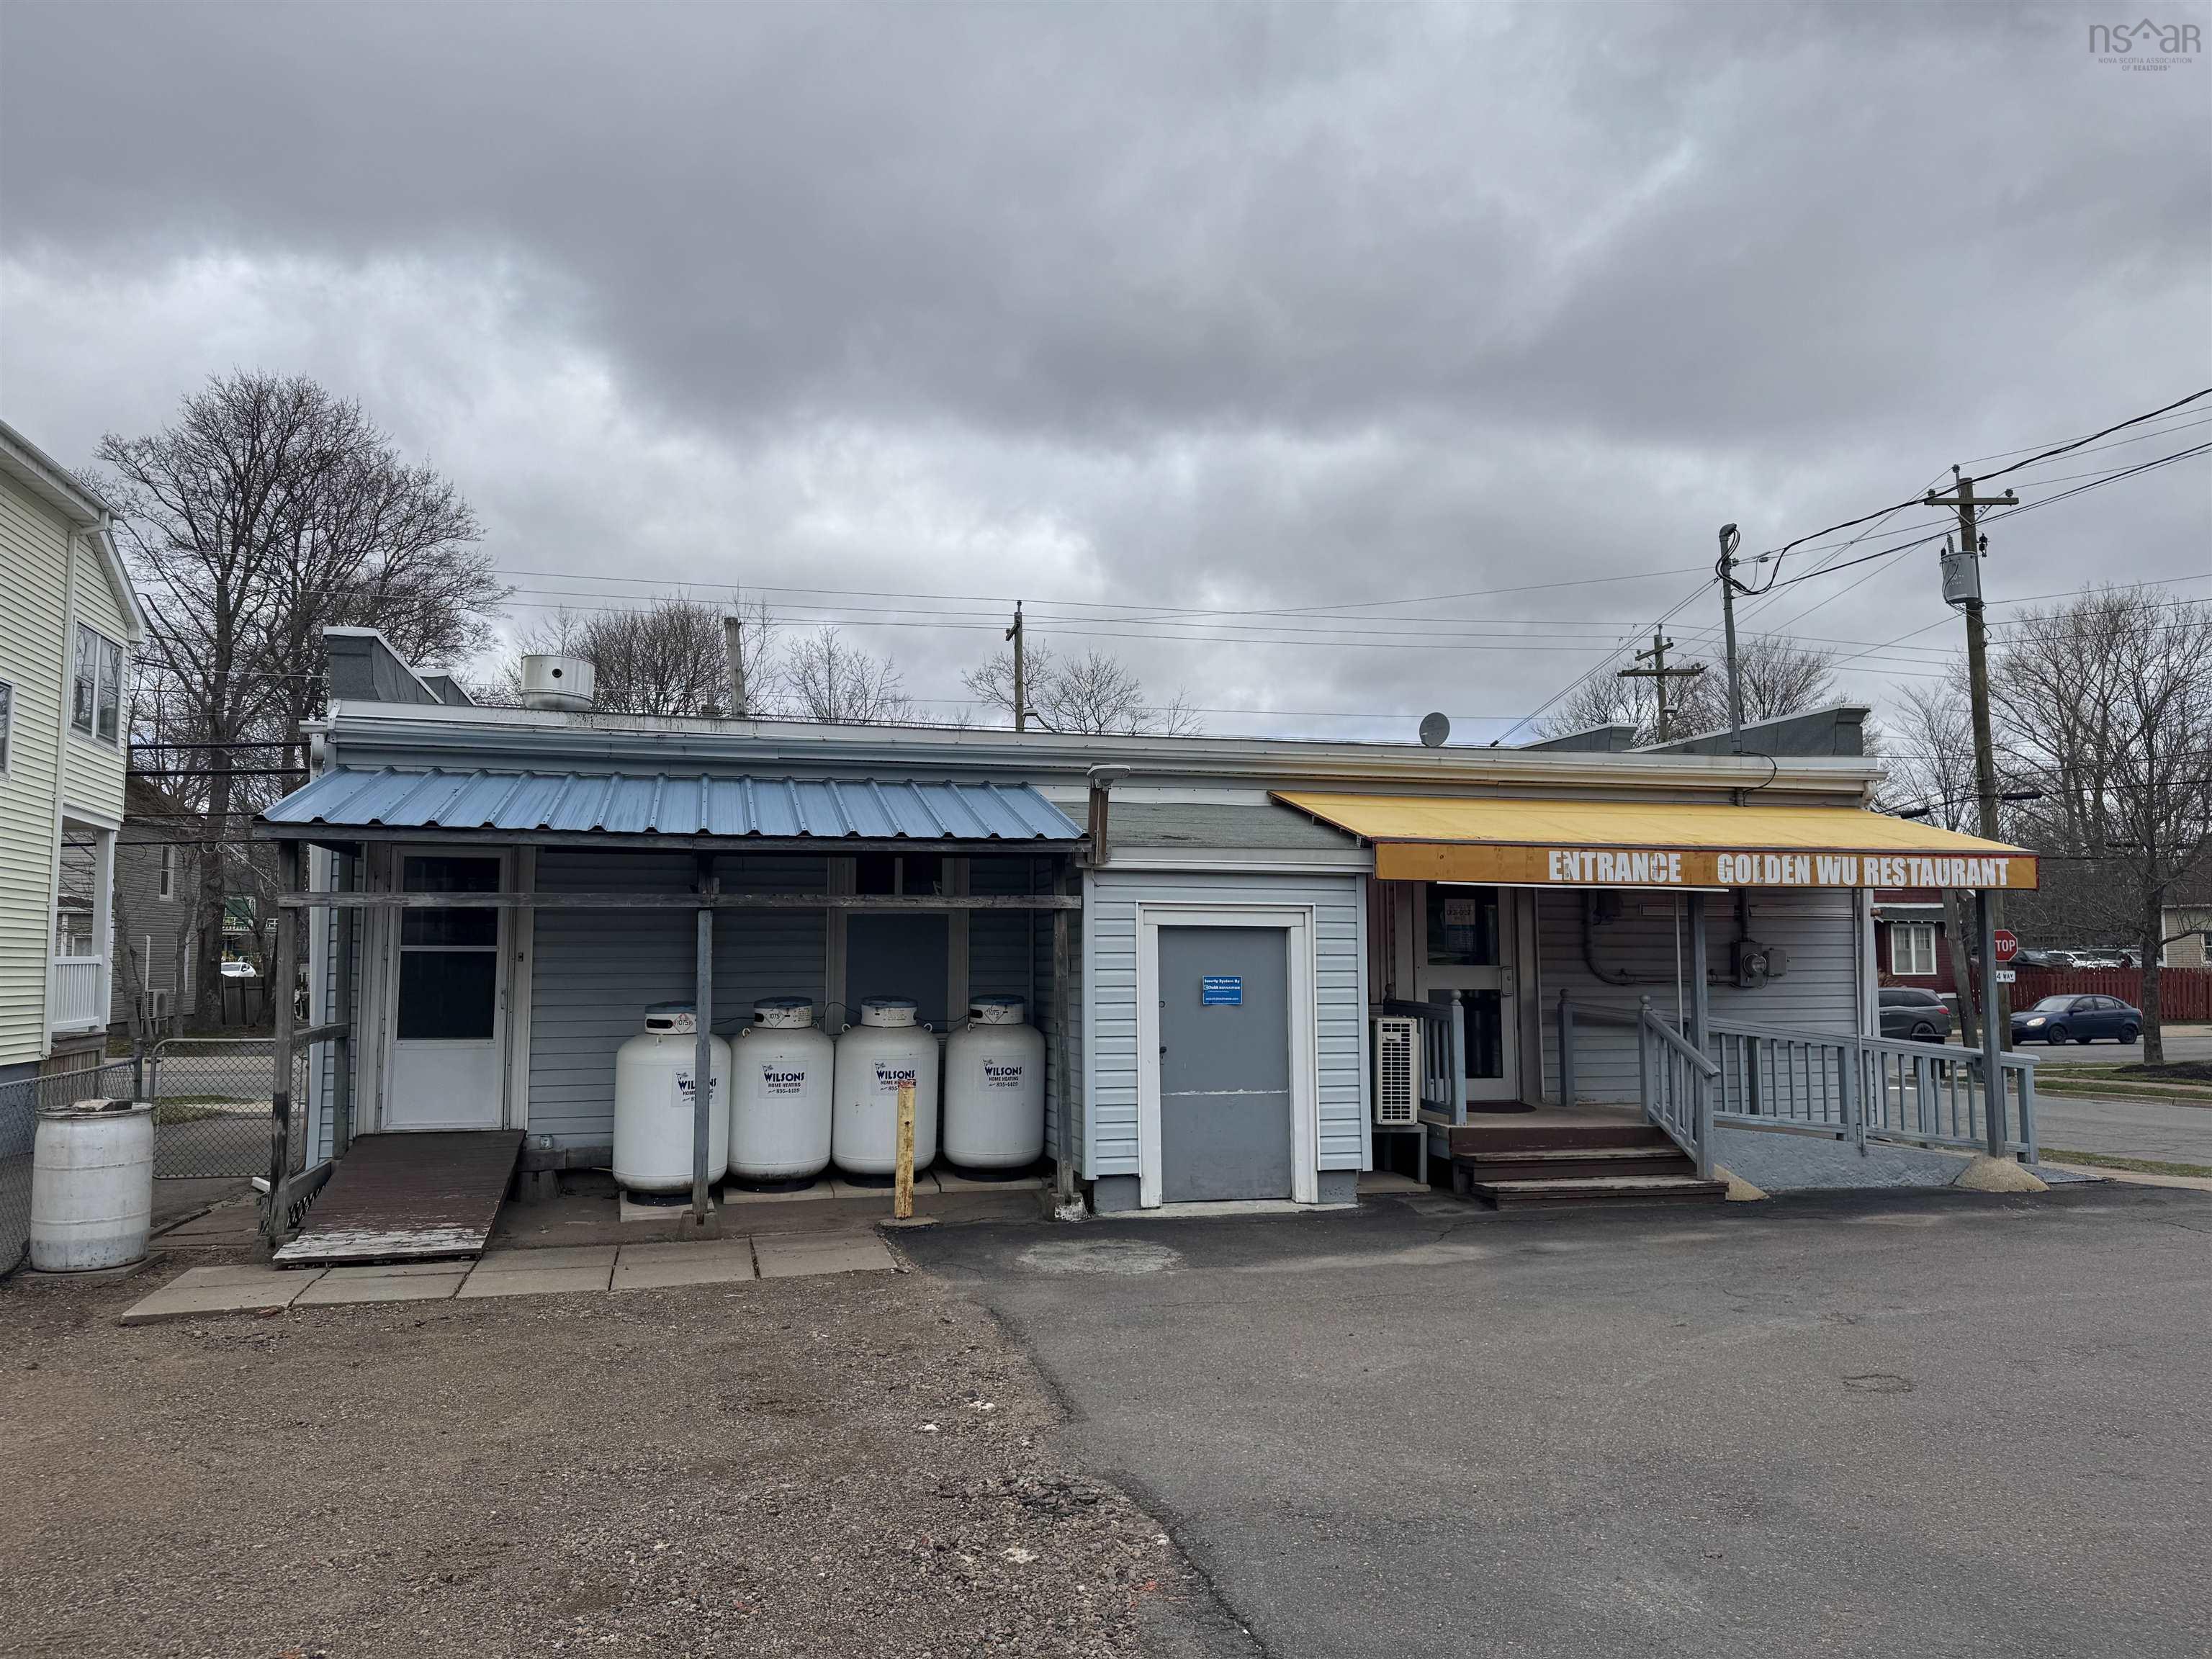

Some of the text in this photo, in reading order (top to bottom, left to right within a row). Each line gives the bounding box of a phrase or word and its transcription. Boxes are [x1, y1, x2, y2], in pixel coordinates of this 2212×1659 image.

[1549, 850, 2009, 887] ENTRANCE GOLDEN WU RESTAURANT
[1995, 940, 2015, 952] TOP
[876, 1069, 915, 1080] WILSONS
[984, 1066, 1022, 1076] WILSONS
[764, 1072, 804, 1083] WILSONS
